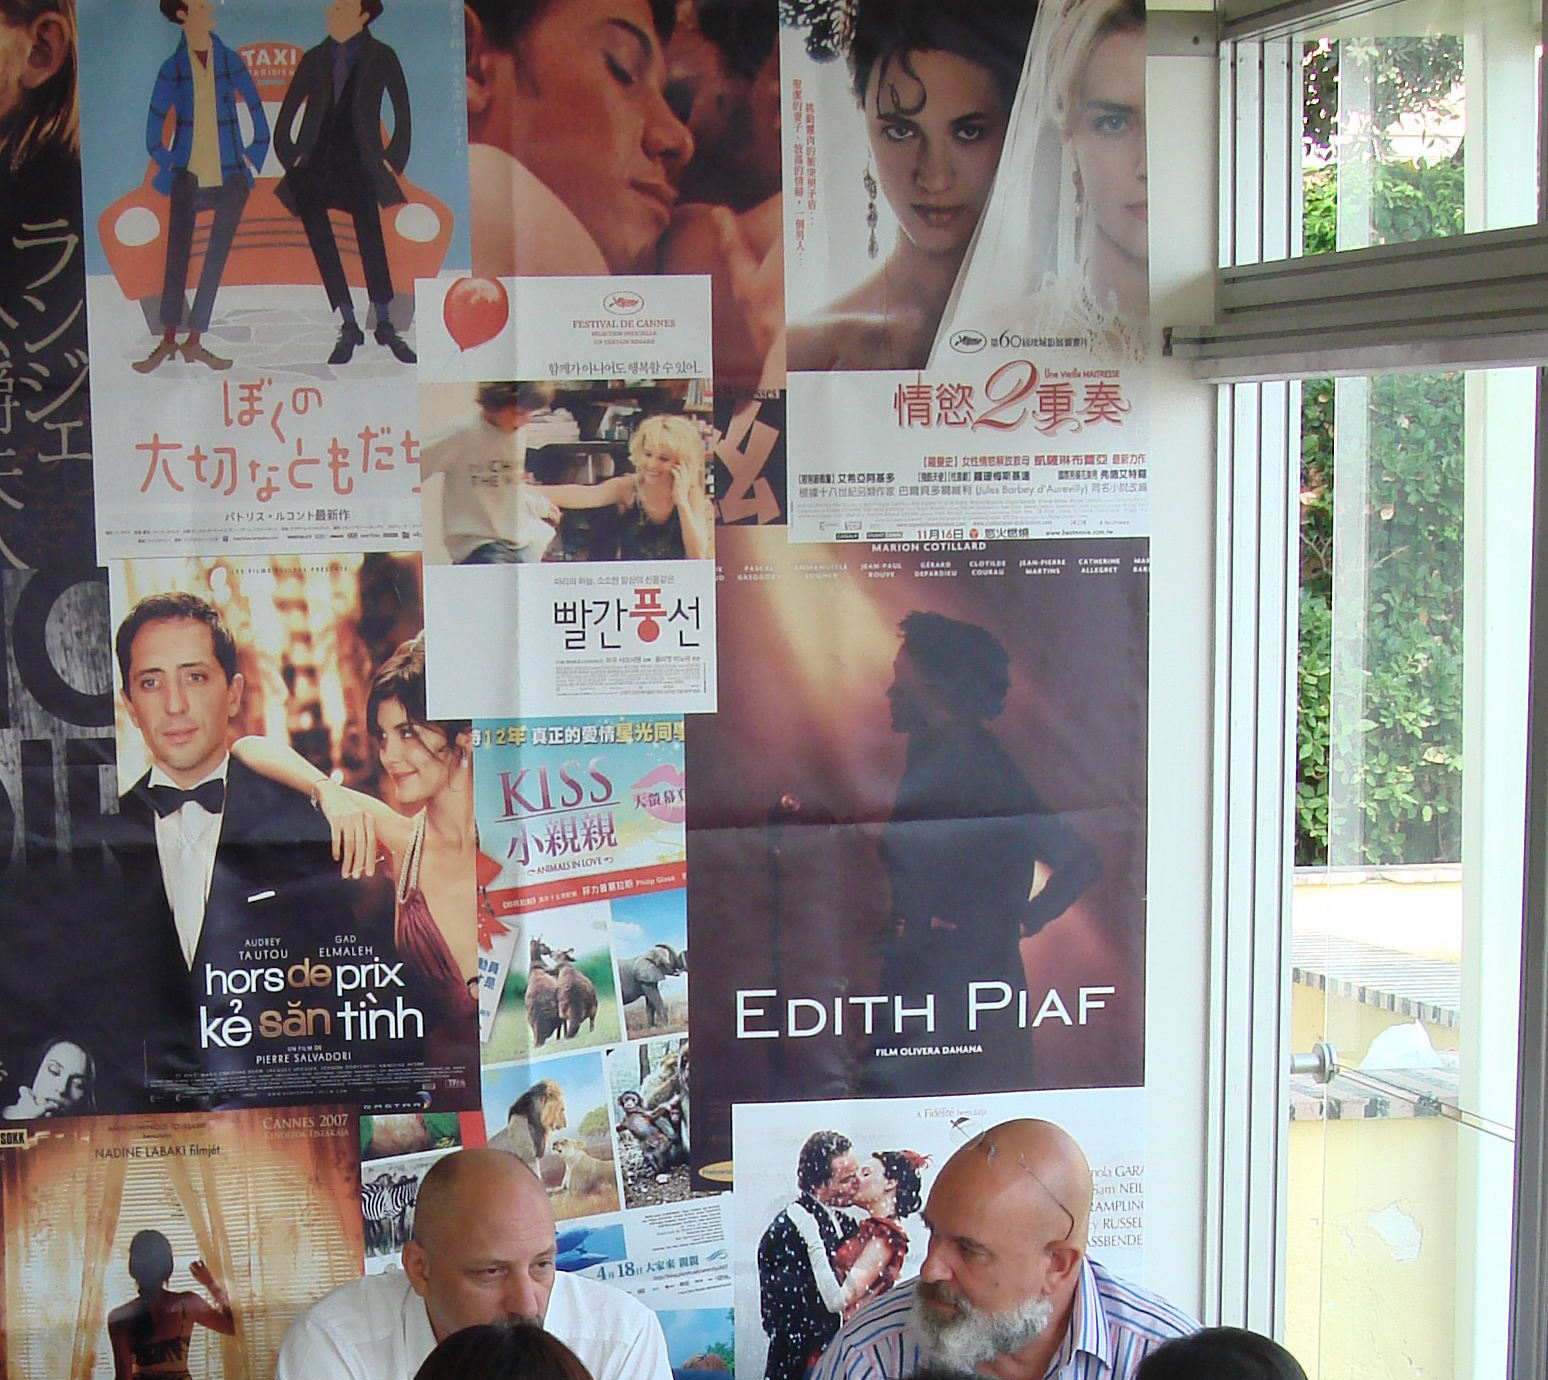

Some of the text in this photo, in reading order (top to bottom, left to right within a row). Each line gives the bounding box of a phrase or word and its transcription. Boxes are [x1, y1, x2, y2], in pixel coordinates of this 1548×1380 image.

[241, 48, 297, 66] TAXI
[572, 319, 676, 329] FESTIVAL DE CANNES
[582, 362, 626, 375] 아니어도
[662, 361, 674, 374] 수
[893, 360, 1132, 436] 情慾2重奏
[223, 377, 322, 444] ぼくの
[1002, 484, 1034, 496] Barbey
[917, 528, 963, 540] 11月16日
[872, 542, 987, 553] MARION COTILLARD
[860, 562, 902, 571] JEAN-PAUL
[969, 559, 1007, 568] CLOTILDE
[1018, 558, 1067, 567] JEAN-PIERRE
[1078, 557, 1121, 566] CATHERINE
[744, 564, 774, 572] PASCAL
[914, 569, 957, 578] DEPARDIEU
[971, 568, 1004, 576] COURAU
[1025, 567, 1061, 575] MARTINS
[868, 571, 895, 579] ROUVE
[554, 588, 700, 650] 빨간풍선
[497, 755, 613, 817] KISS
[507, 810, 618, 867] 小親親
[536, 858, 602, 875] ANIMALS IN LOVE
[244, 937, 281, 948] AUDREY
[334, 934, 357, 944] GAD
[238, 949, 288, 961] TAUTOU
[318, 946, 373, 958] ELMALEH
[205, 956, 405, 997] hors de prix
[736, 980, 1115, 1039] EDITH PIAF
[200, 992, 424, 1049] kẻ săn tình
[875, 1045, 983, 1057] FILM OLIVERA DAHANA
[256, 1052, 351, 1065] PIERRE SALVADORI
[262, 1113, 348, 1130] CANNES 2007
[95, 1144, 220, 1159] NADINE LABAKI filmjét
